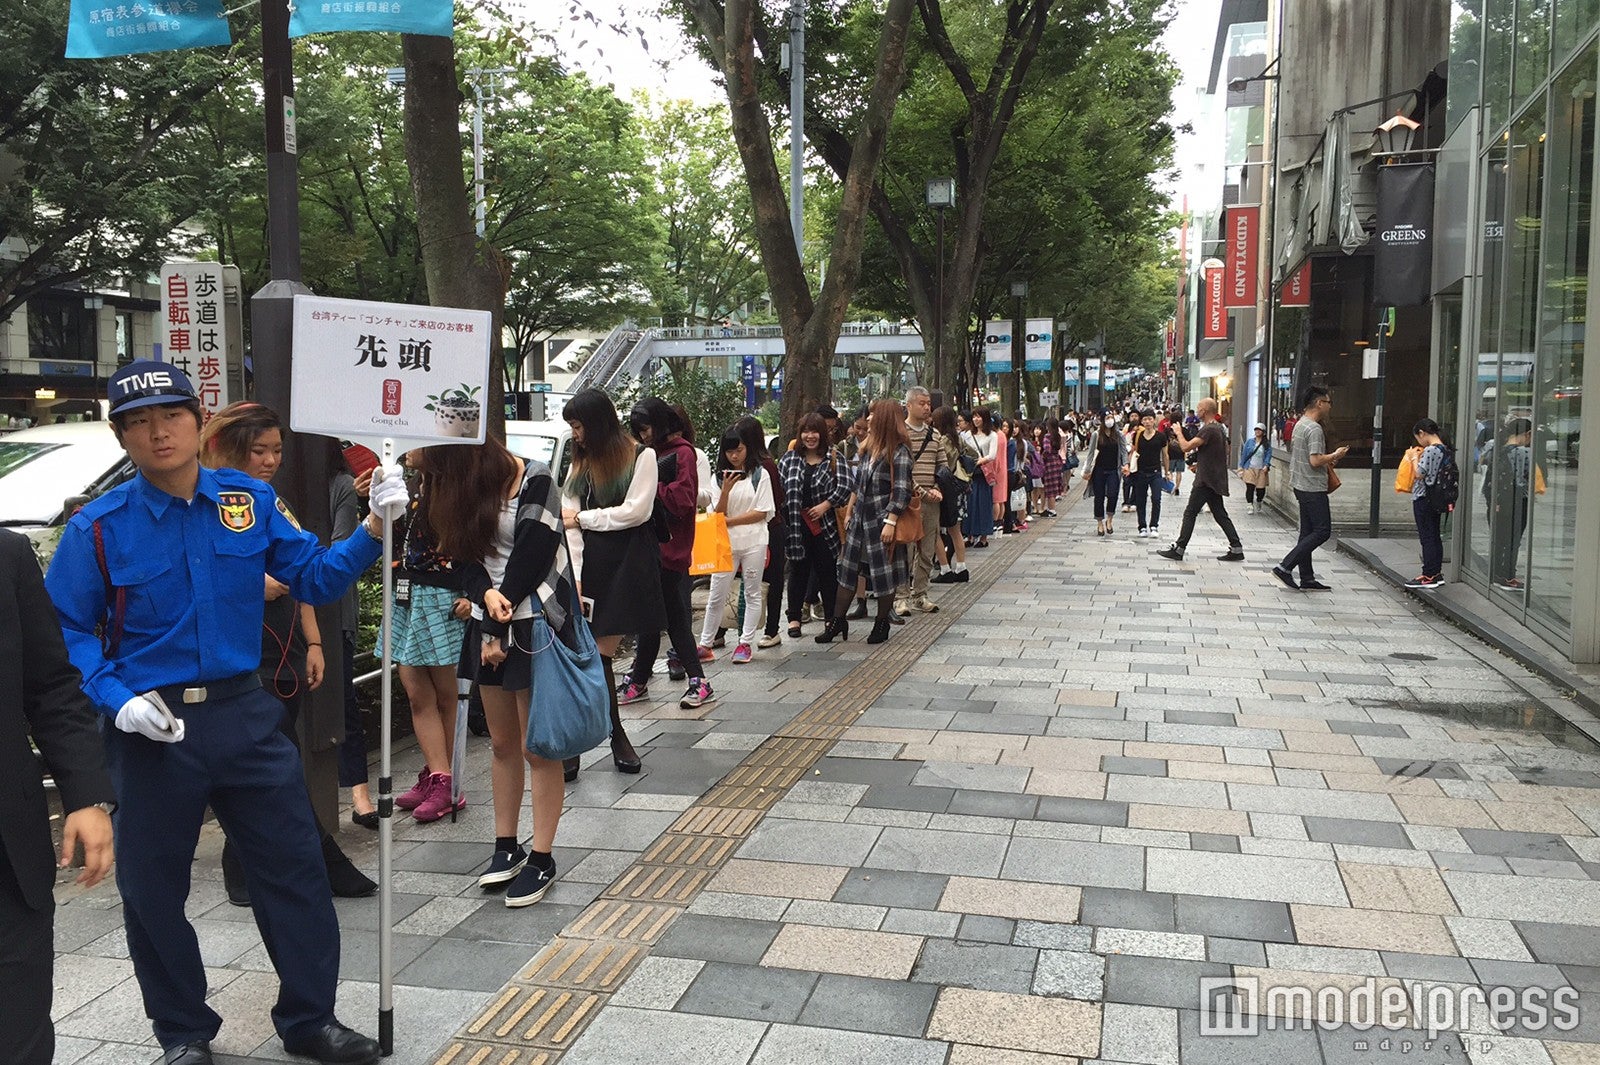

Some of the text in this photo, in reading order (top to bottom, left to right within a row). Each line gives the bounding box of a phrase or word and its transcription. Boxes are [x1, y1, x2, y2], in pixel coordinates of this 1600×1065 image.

[1381, 229, 1426, 241] GREENS
[354, 334, 432, 373] 先頭
[116, 371, 173, 394] TMS
[371, 416, 409, 427] Gong cha
[220, 496, 246, 504] TMS
